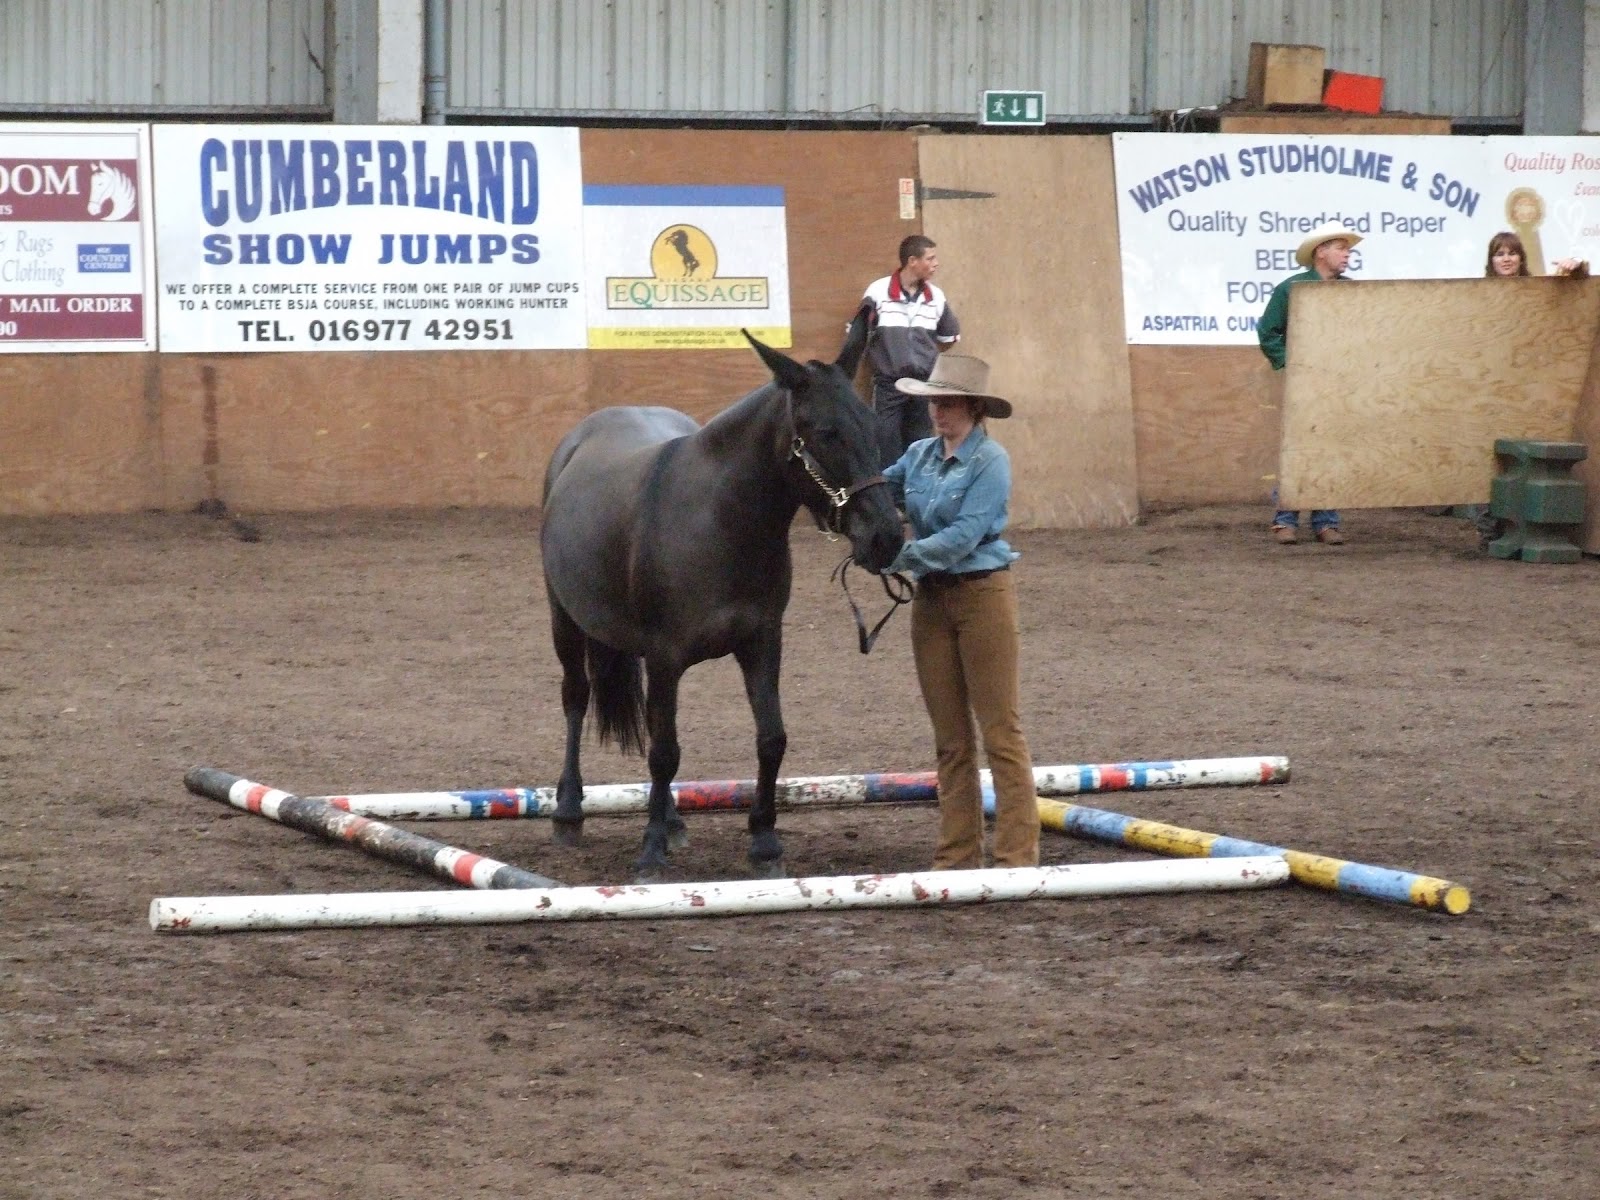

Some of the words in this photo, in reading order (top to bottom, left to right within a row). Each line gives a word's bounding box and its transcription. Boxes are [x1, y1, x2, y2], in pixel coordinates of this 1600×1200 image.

[1504, 151, 1566, 174] Quality
[200, 138, 539, 227] CUMBERLAND
[1128, 153, 1231, 213] WATSON
[1238, 144, 1393, 183] STUDHOLME
[1401, 162, 1418, 191] &
[1429, 173, 1480, 217] SON
[1168, 209, 1247, 236] Quality
[1381, 212, 1447, 237] Paper
[16, 230, 54, 257] Rugs
[203, 233, 352, 265] SHOW
[378, 233, 540, 265] JUMPS
[1256, 249, 1363, 271] BEDG
[2, 259, 65, 287] Clothing
[166, 284, 186, 295] WE
[193, 284, 232, 295] OFFER
[238, 284, 246, 295] A
[252, 284, 318, 295] COMPLETE
[324, 284, 377, 295] SERVICE
[383, 284, 418, 294] FROM
[424, 284, 448, 294] ONE
[454, 284, 483, 294] PAIR
[489, 283, 504, 294] OF
[509, 283, 541, 294] JUMP
[547, 283, 580, 293] CUPS
[614, 281, 764, 308] EQUISSAGE
[9, 298, 60, 313] MAIL
[67, 298, 134, 313] ORDER
[179, 300, 195, 311] TO
[201, 299, 209, 311] A
[215, 299, 281, 311] COMPLETE
[288, 299, 318, 310] BSJA
[324, 299, 379, 311] COURSE,
[383, 298, 450, 309] INCLUDING
[455, 298, 514, 309] WORKING
[520, 298, 568, 309] HUNTER
[238, 321, 294, 341] TEL.
[308, 320, 412, 341] 016977
[424, 319, 514, 340] 42951
[1142, 315, 1219, 331] ASPATRIA
